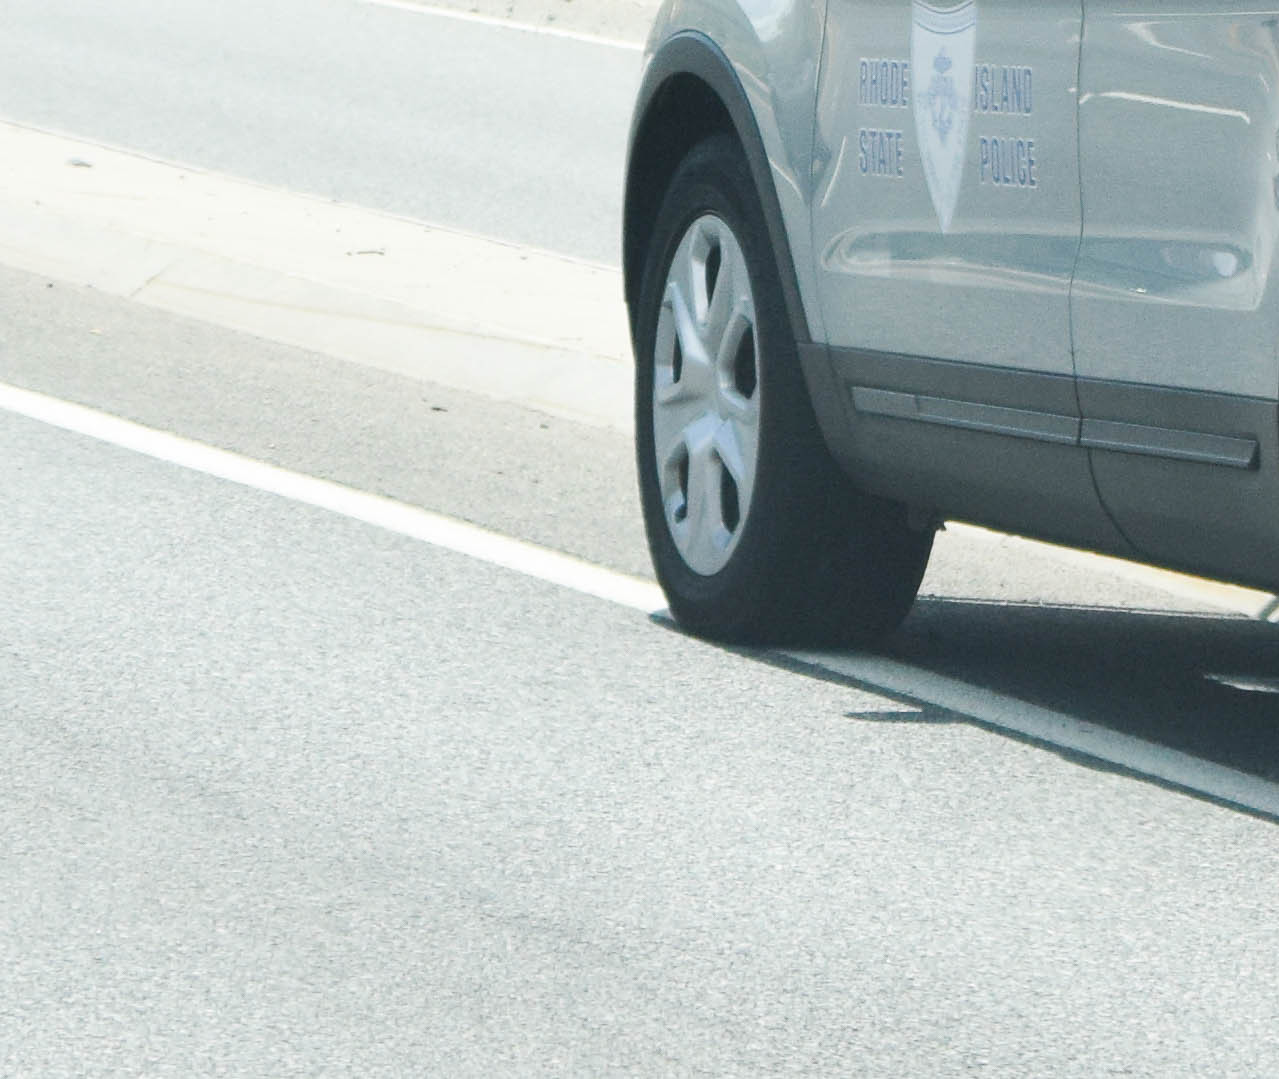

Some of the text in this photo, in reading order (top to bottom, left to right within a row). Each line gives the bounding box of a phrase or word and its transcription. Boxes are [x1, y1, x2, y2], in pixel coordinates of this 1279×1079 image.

[859, 57, 1033, 116] RHODE ISLAND
[858, 128, 1038, 189] STATE POLICE
